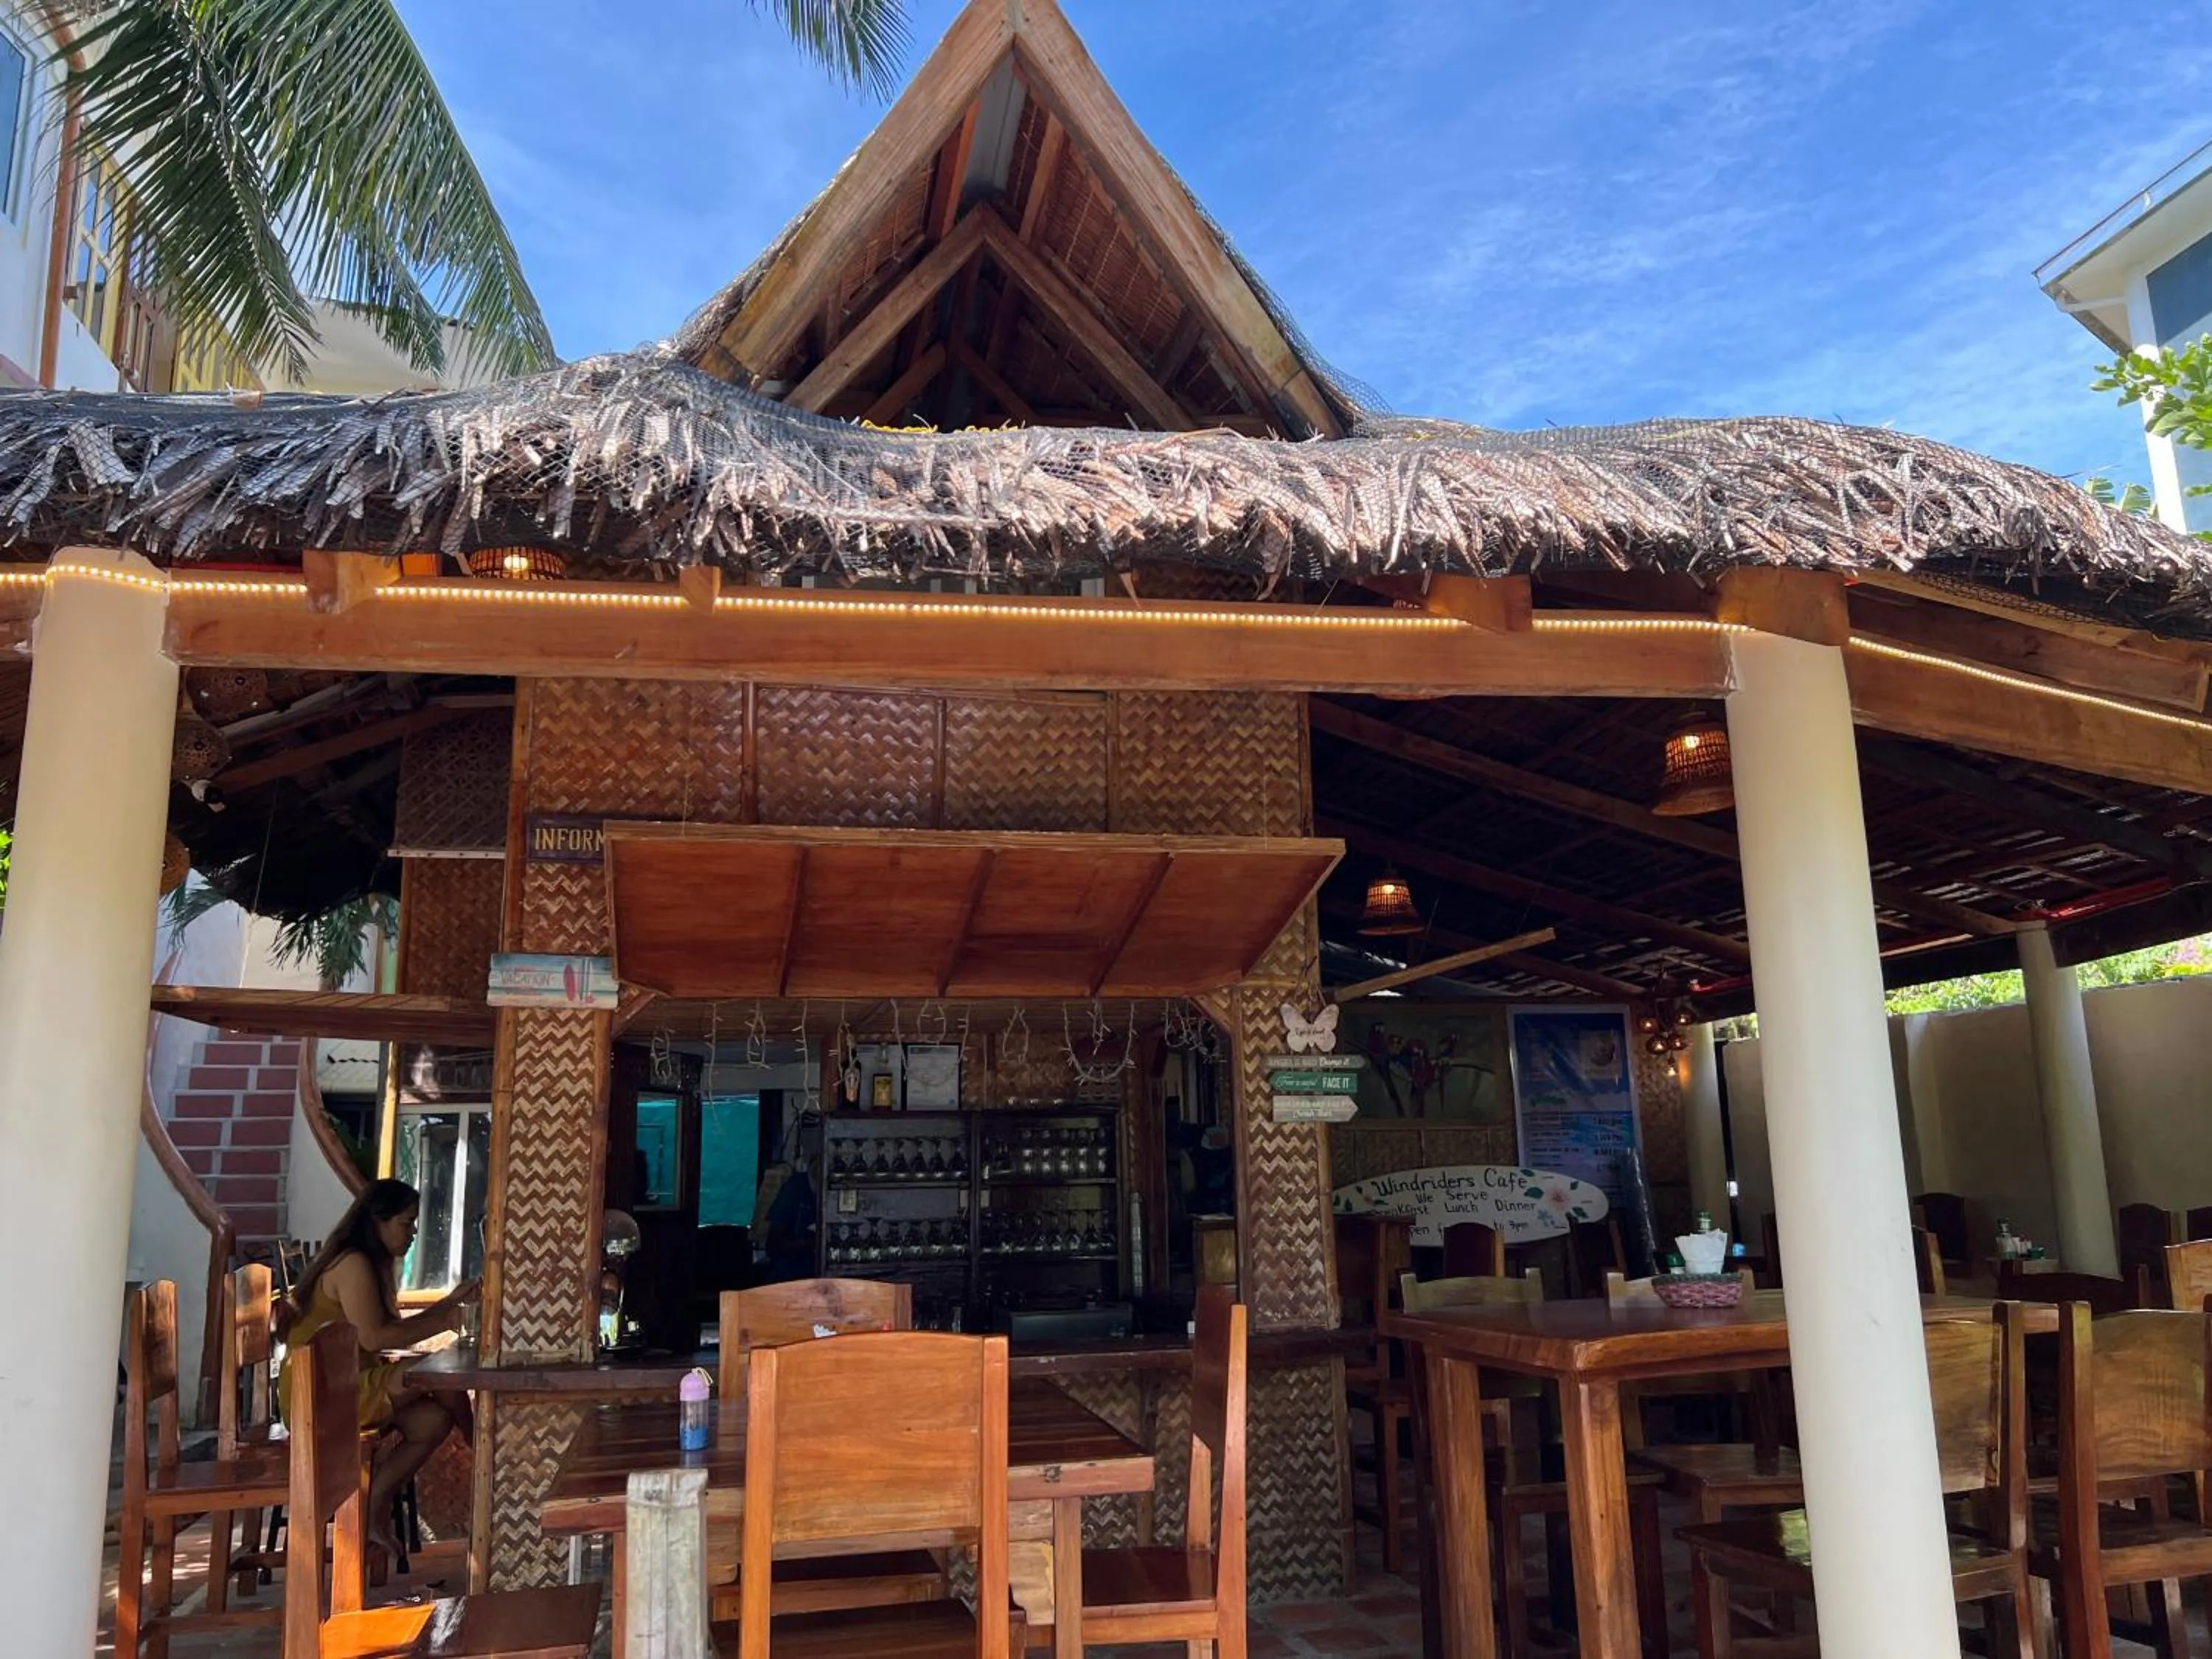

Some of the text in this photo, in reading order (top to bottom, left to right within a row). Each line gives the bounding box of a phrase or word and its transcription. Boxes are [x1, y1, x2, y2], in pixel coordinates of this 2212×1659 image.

[1371, 1168, 1528, 1197] Windriders Cafe
[1416, 1189, 1488, 1203] We Serve
[1444, 1202, 1479, 1214] Lunch
[1495, 1200, 1537, 1212] Dinner
